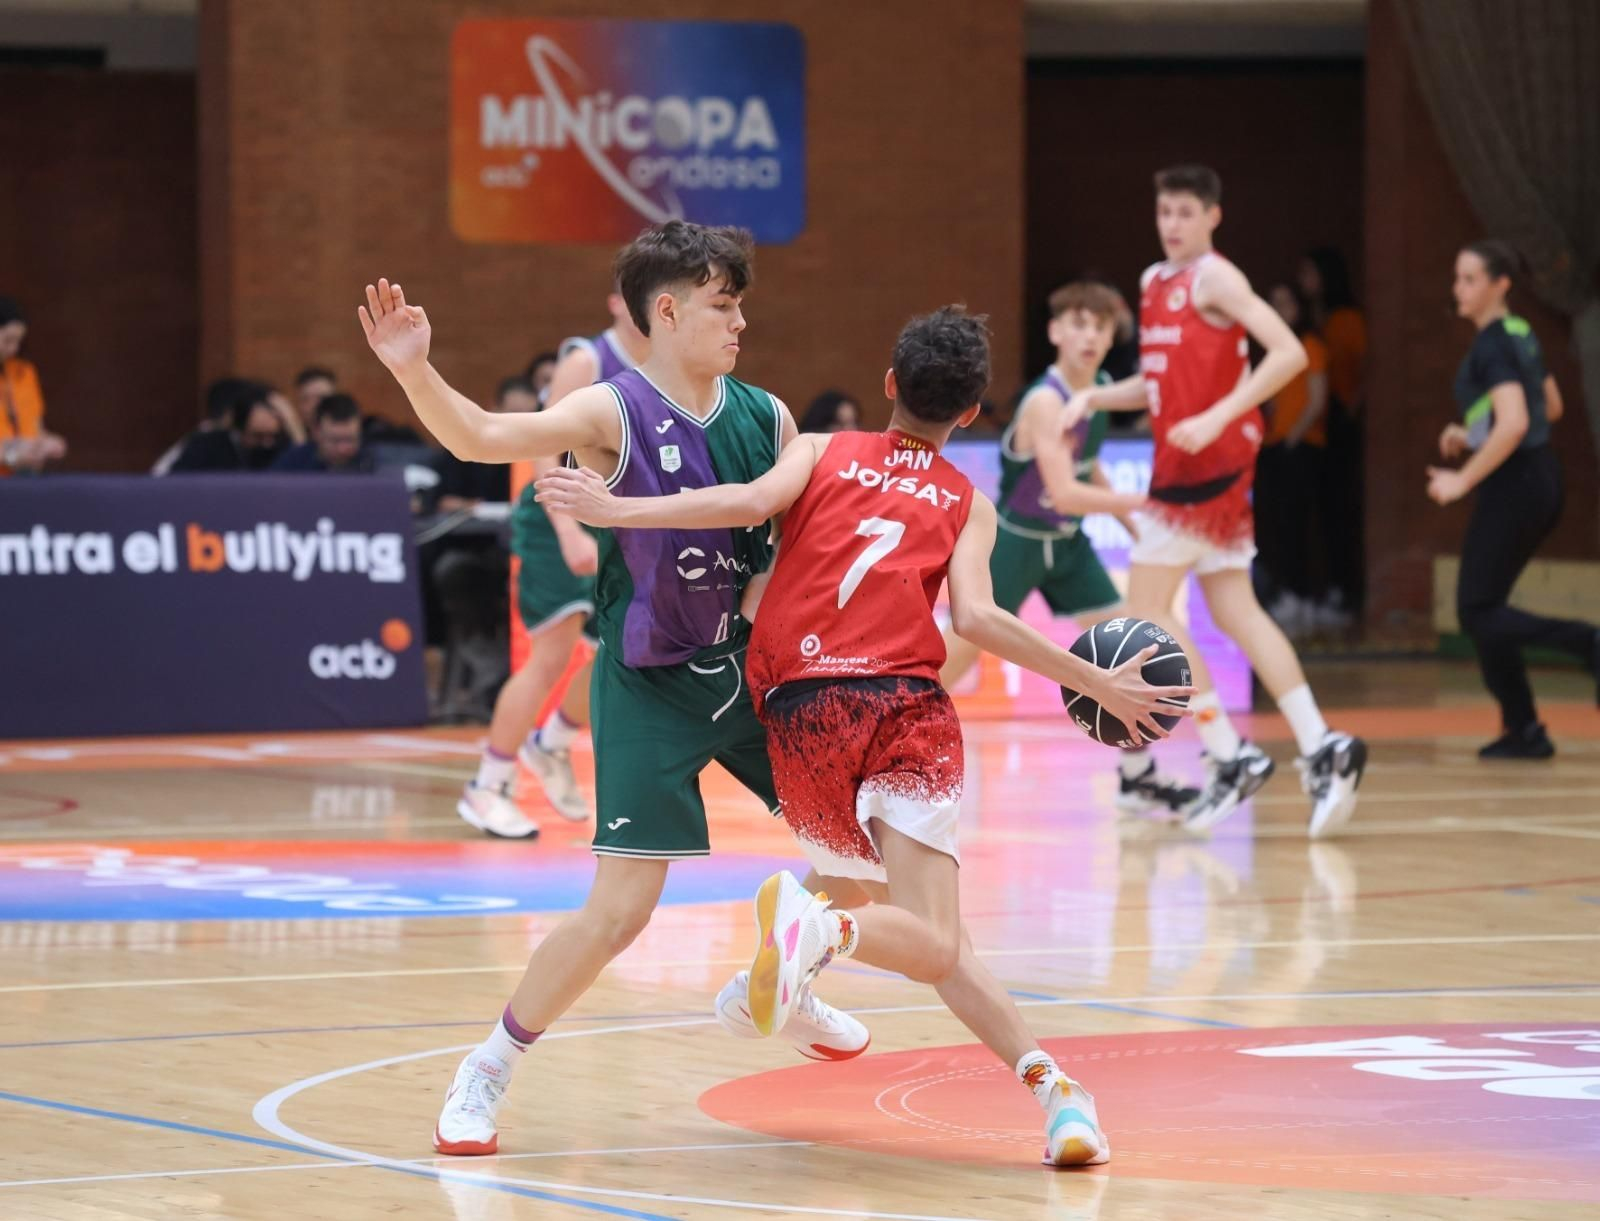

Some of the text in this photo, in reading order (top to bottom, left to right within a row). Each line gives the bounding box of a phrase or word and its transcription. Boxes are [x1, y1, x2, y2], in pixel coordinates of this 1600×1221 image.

[884, 449, 933, 471] JAN
[838, 460, 961, 512] JOYSAT
[123, 523, 177, 574] el
[186, 517, 406, 583] bullying
[837, 516, 907, 610] 7
[309, 638, 396, 680] acb
[819, 654, 869, 665] Manresa
